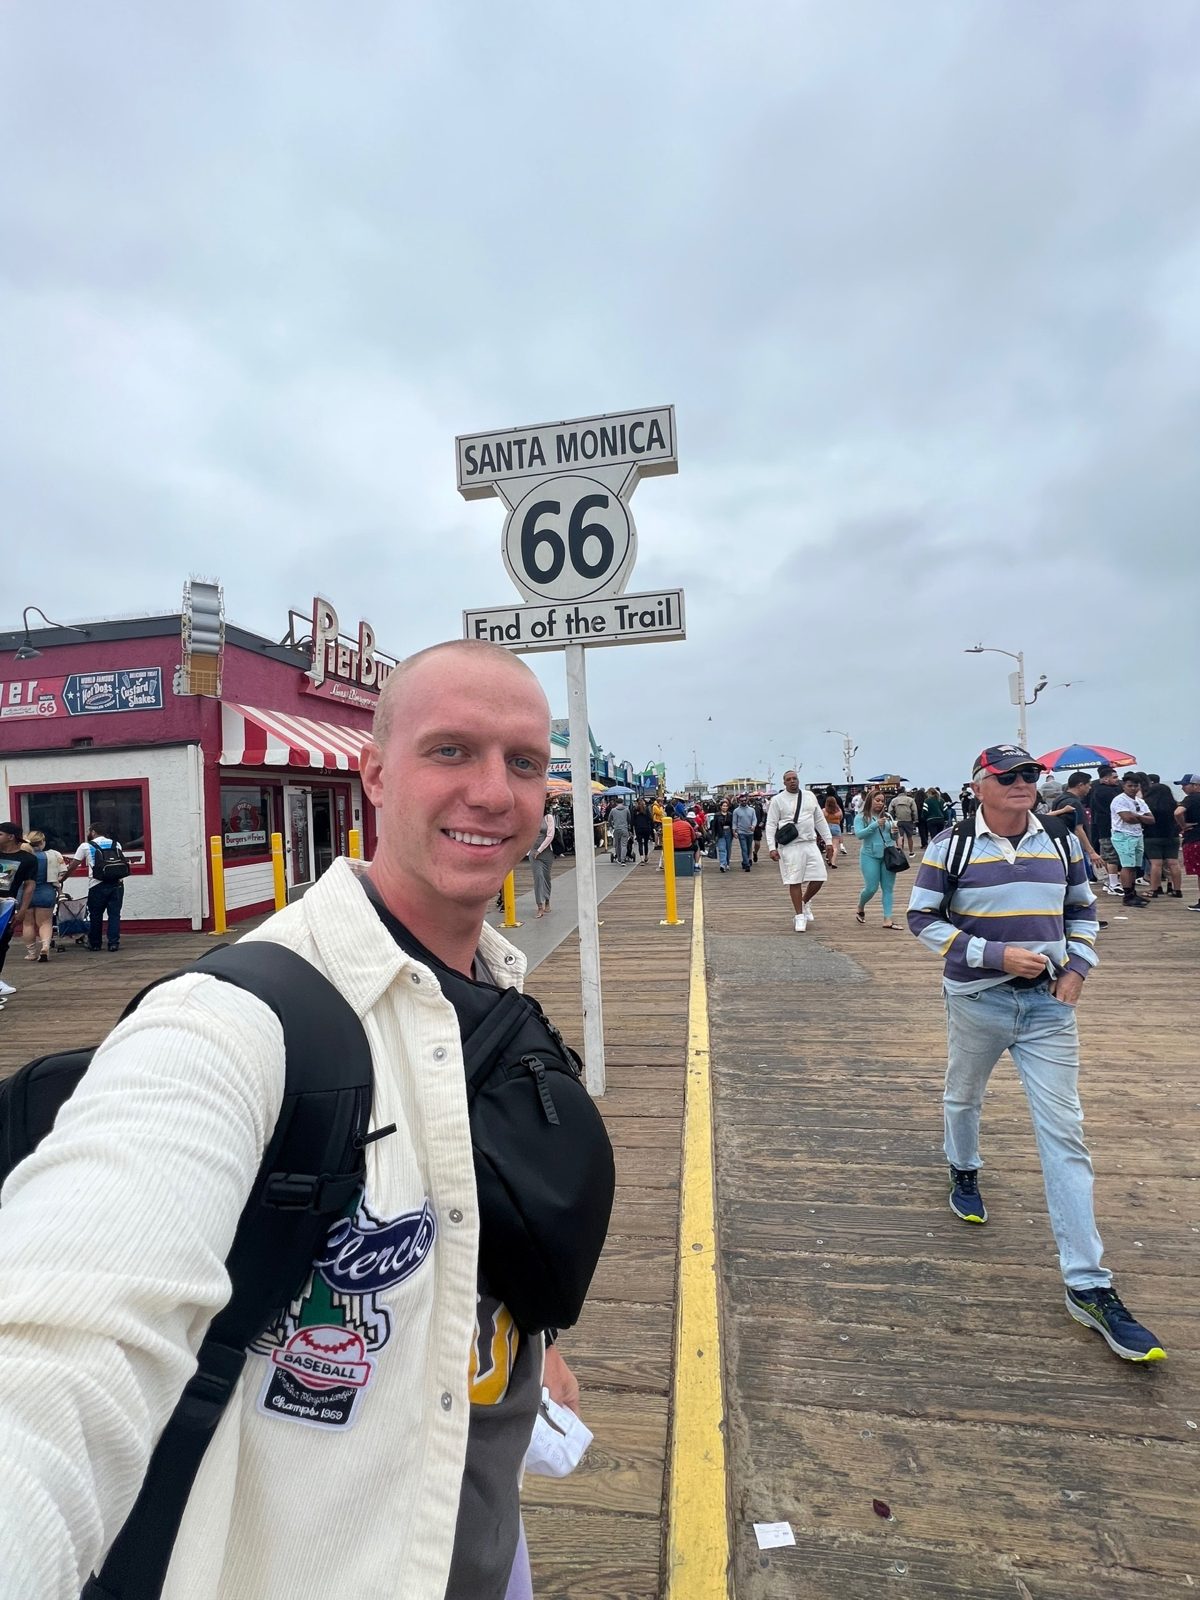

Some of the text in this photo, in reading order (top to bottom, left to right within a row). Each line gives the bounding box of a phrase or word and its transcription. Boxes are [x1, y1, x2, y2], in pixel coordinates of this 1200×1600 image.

[464, 419, 666, 476] SANTA MONICA
[521, 494, 615, 584] 66
[475, 597, 673, 642] End of the Trail
[0, 681, 38, 706] er
[82, 683, 113, 704] Hot Dogs
[121, 681, 149, 700] Custard
[129, 694, 156, 707] Shakes
[39, 702, 54, 713] 66
[284, 1354, 356, 1379] BASEBALL
[272, 1395, 343, 1420] Champs 1969
